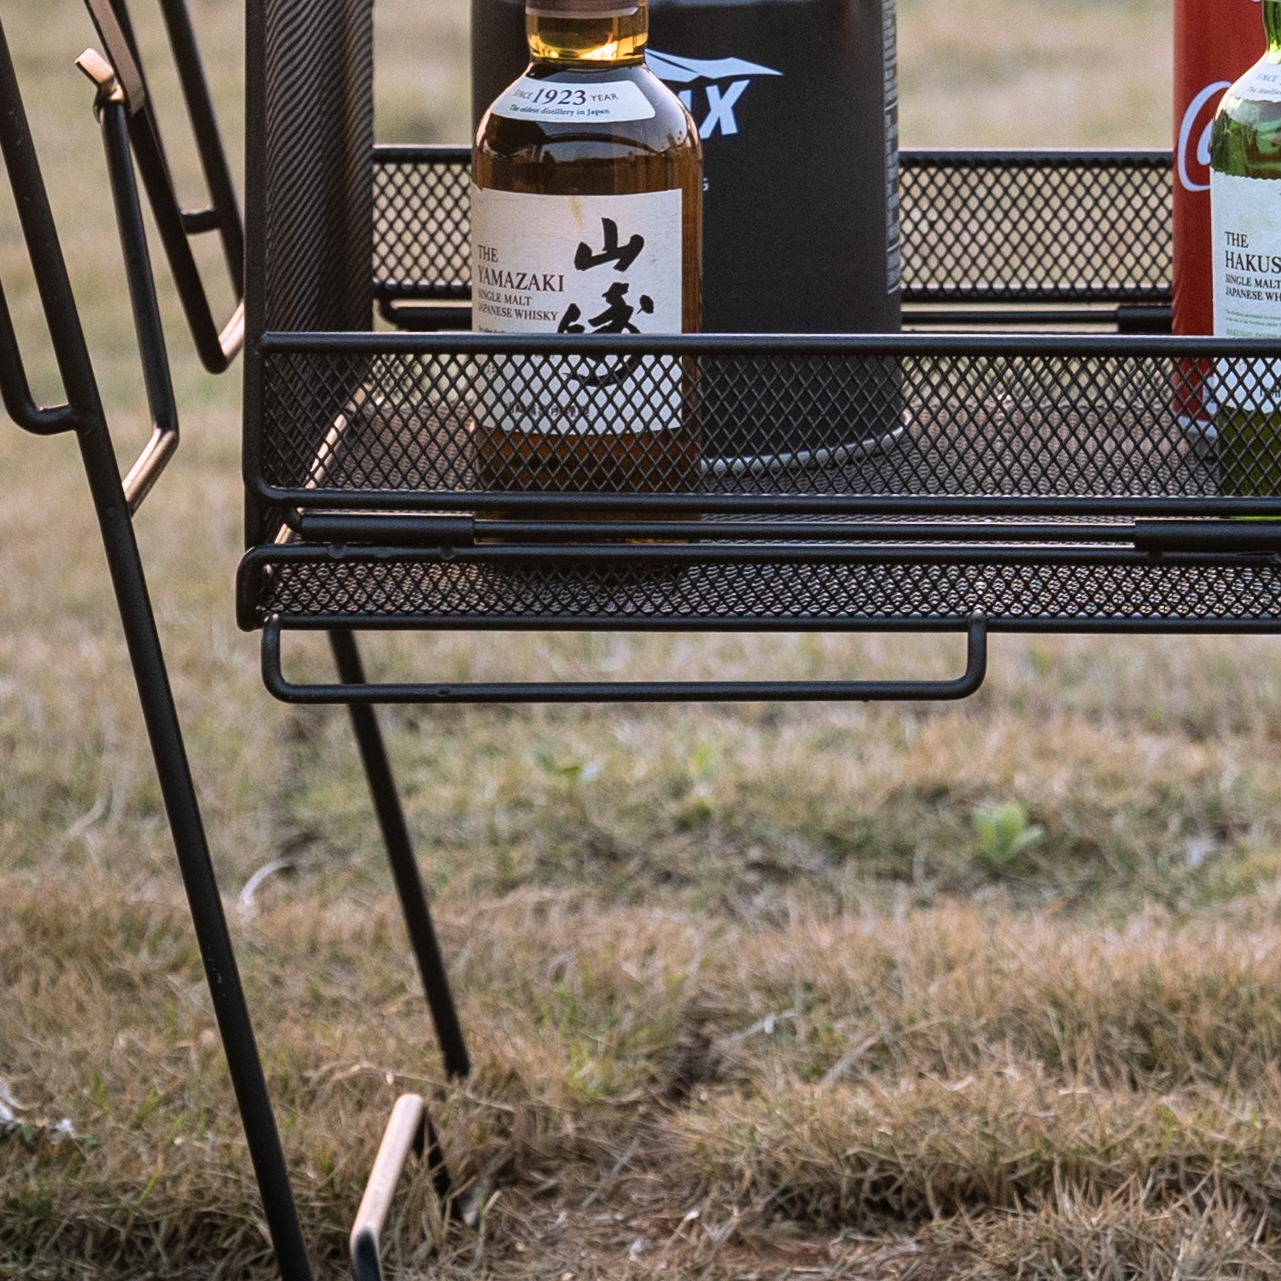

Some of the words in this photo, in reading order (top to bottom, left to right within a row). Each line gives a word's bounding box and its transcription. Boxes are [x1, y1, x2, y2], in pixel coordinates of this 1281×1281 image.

[532, 88, 586, 105] 1923
[590, 92, 619, 102] YEAR
[587, 108, 610, 117] Japan
[1225, 231, 1249, 248] THE
[478, 244, 499, 263] THE
[478, 265, 564, 292] YAMAZAKI
[1225, 274, 1252, 287] SINGLE
[478, 288, 502, 303] SINGLE
[504, 295, 533, 306] MALT
[1225, 286, 1263, 300] JAPANESE
[478, 302, 512, 318] JAPANESE
[514, 309, 558, 321] WHISKY
